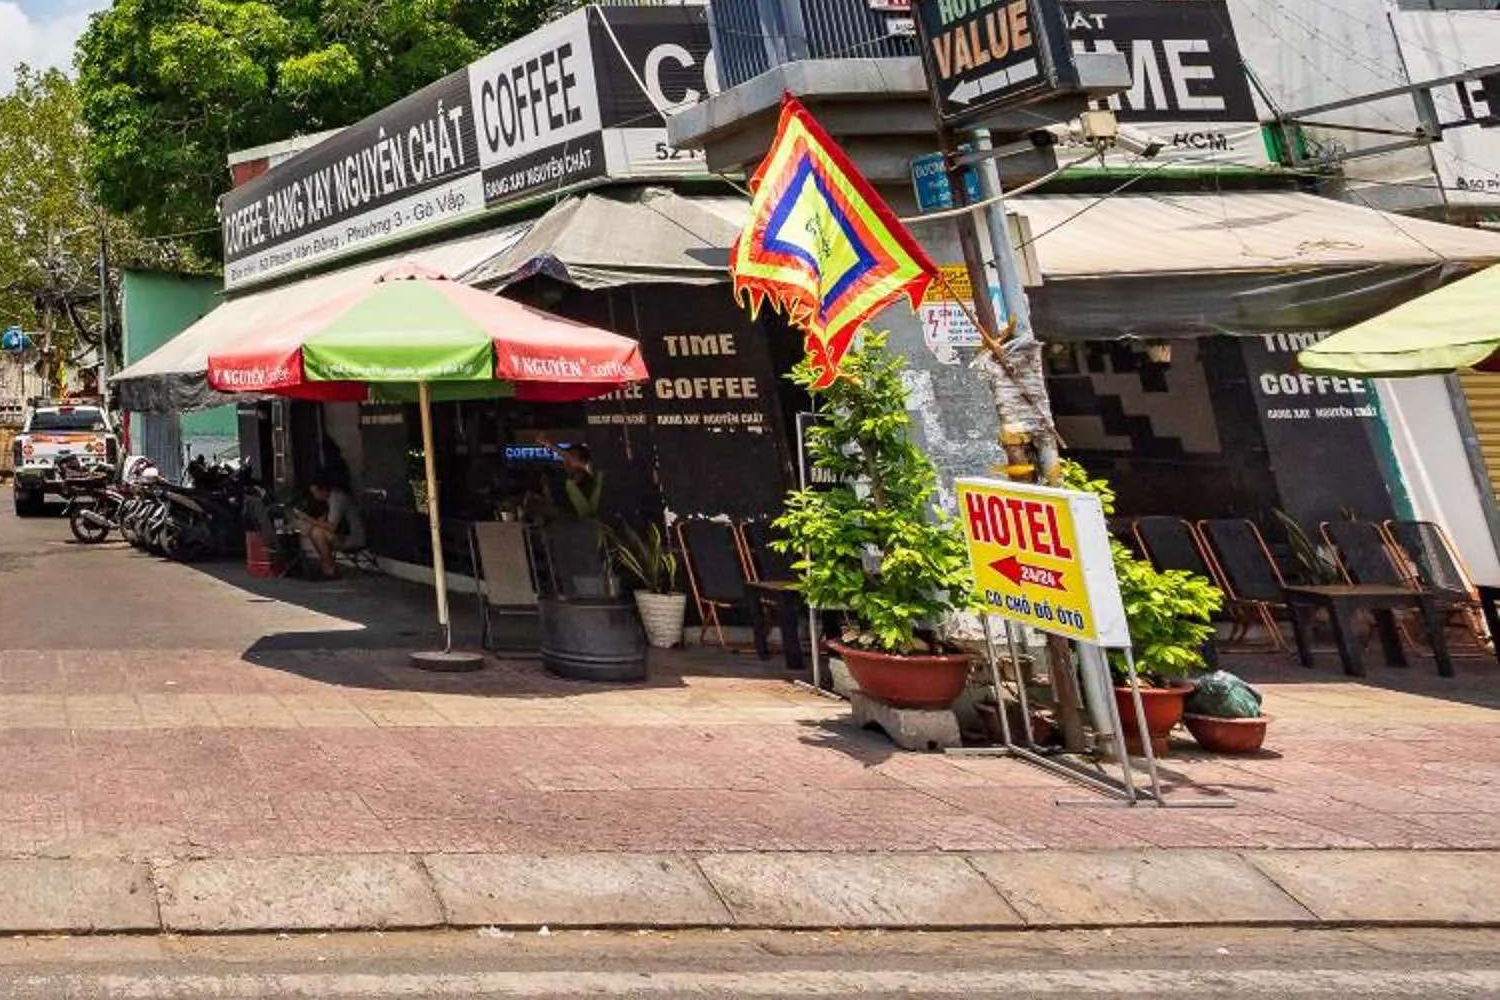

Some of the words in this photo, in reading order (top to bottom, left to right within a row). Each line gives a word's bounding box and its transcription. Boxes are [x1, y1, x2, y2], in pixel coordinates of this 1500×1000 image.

[481, 42, 583, 154] COFFEE
[223, 201, 266, 256] COFFEE
[267, 181, 305, 239] RANG
[304, 167, 334, 225] XAY
[334, 126, 407, 212] NGUYÊN
[408, 100, 467, 183] CHẤT
[394, 212, 402, 228] 3
[663, 333, 737, 357] TIME
[654, 377, 759, 399] COFFEE
[1260, 373, 1366, 395] COFFEE
[965, 491, 1073, 561] HOTEL
[1021, 565, 1057, 586] 24/24
